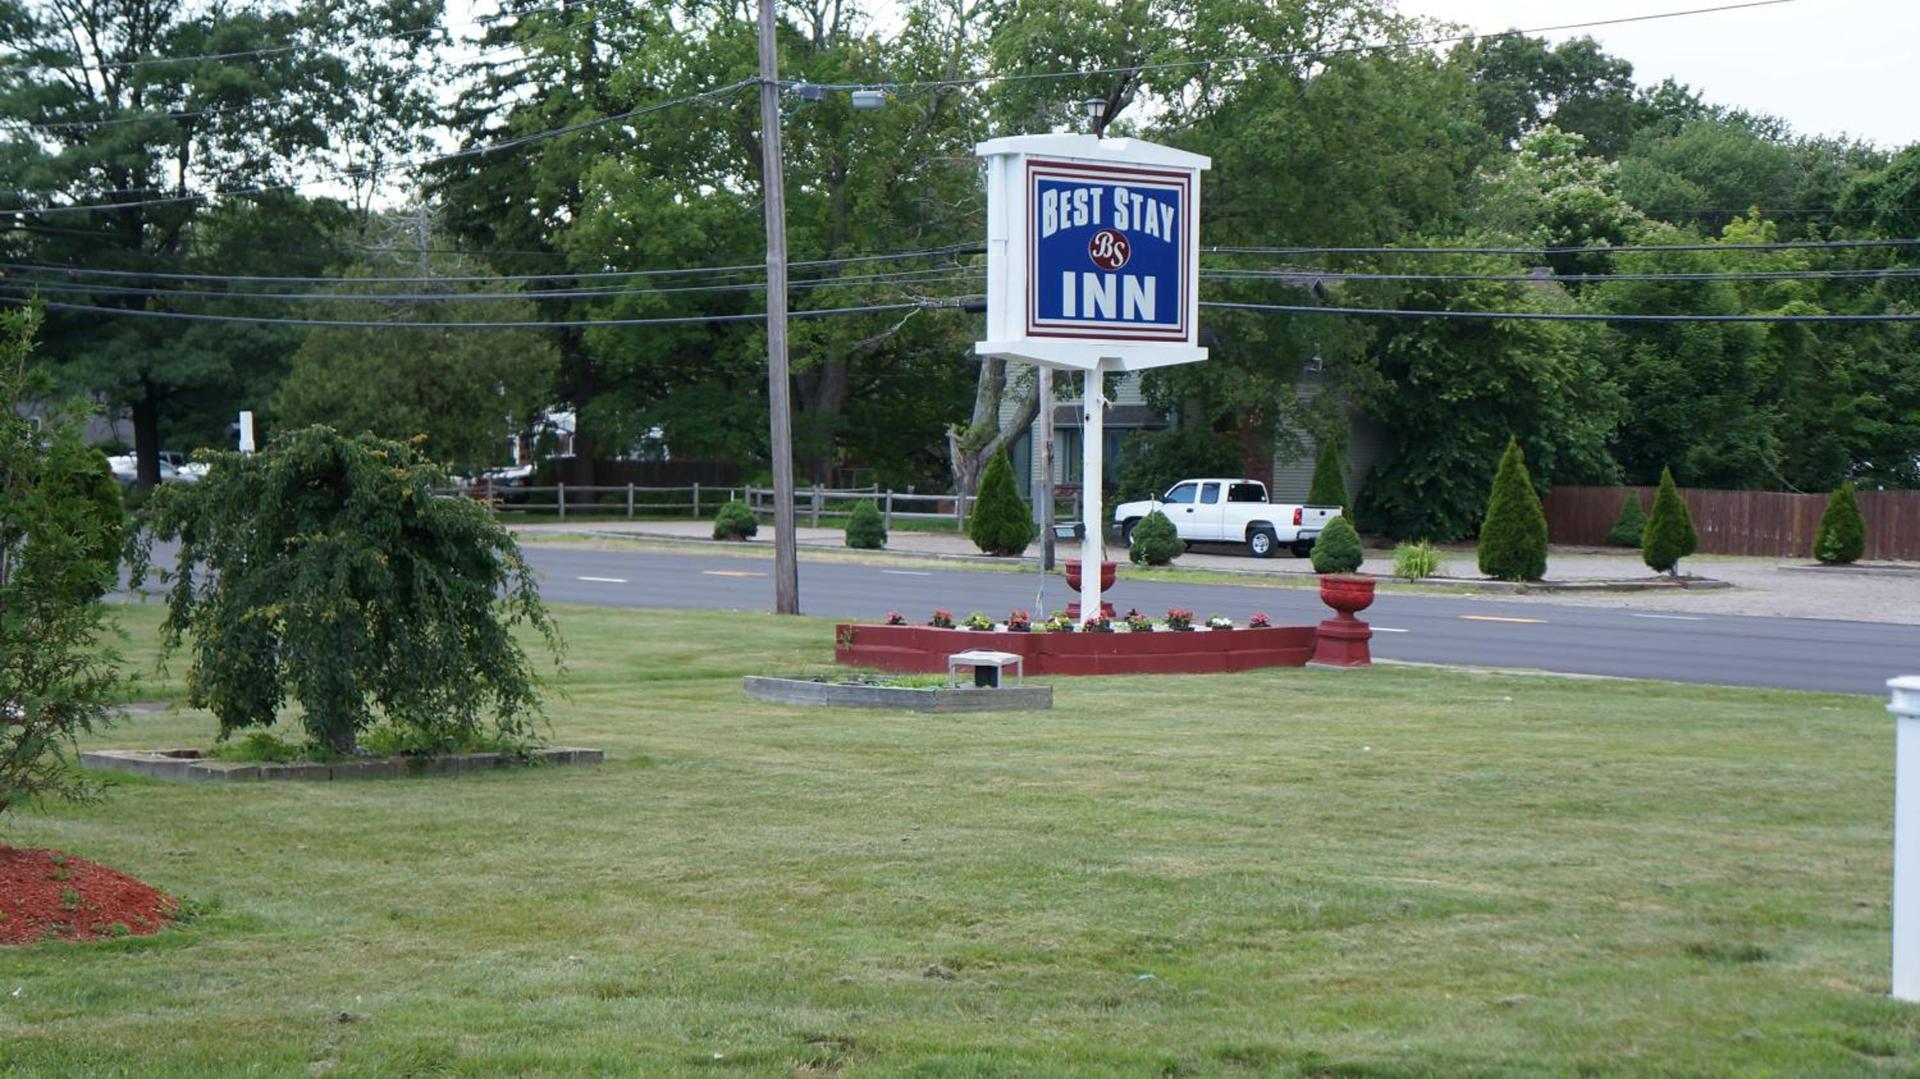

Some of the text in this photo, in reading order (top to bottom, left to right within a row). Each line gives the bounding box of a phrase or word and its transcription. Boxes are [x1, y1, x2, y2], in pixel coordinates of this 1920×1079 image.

[1042, 187, 1175, 243] BEST STAY
[1092, 231, 1126, 268] BS
[1062, 271, 1157, 321] INN
